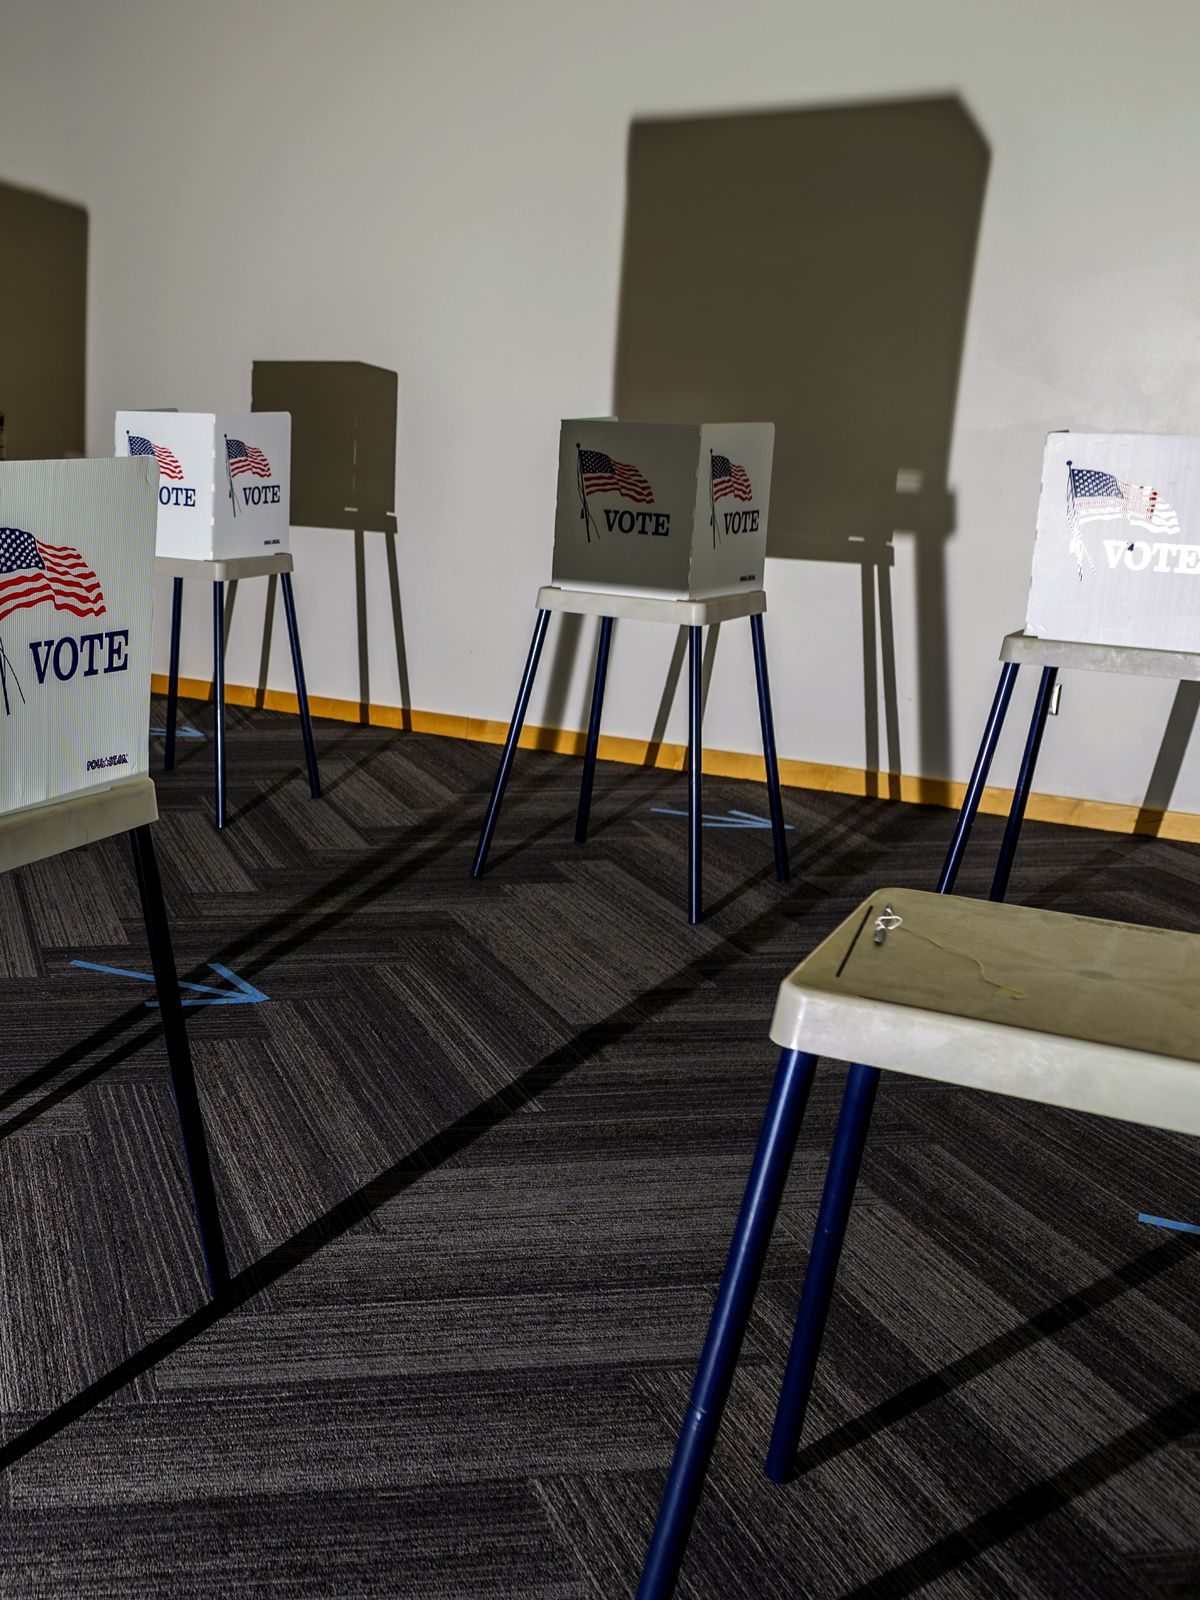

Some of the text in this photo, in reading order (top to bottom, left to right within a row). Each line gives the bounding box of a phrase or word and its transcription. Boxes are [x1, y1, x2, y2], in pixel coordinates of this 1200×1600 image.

[159, 486, 196, 507] OTE
[243, 484, 281, 506] VOTE
[603, 508, 671, 537] VOTE
[723, 509, 760, 536] VOTE
[1103, 538, 1200, 575] VOTE
[29, 629, 129, 685] VOTE
